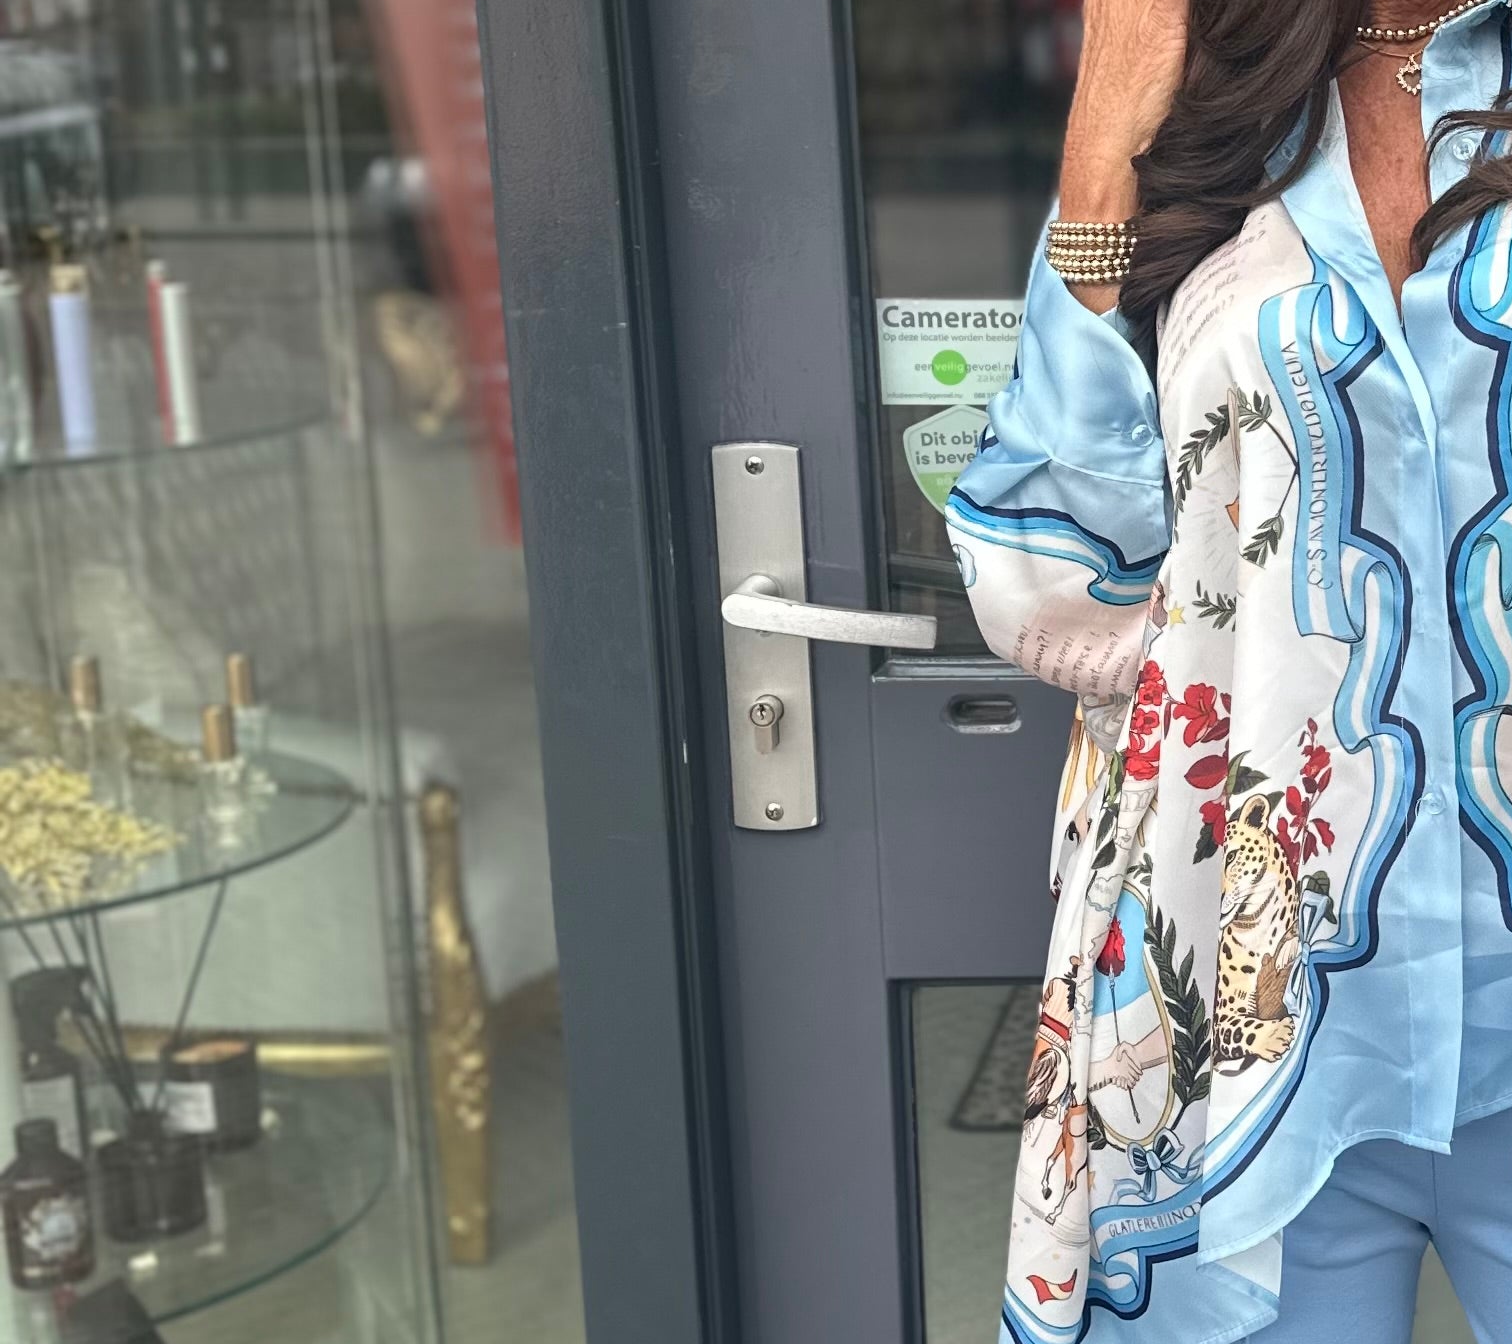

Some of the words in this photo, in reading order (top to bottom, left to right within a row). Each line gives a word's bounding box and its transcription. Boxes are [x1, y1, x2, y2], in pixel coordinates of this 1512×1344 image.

[883, 332, 897, 343] Op
[899, 332, 919, 342] deze
[920, 332, 949, 342] locatie
[951, 332, 984, 342] worden
[920, 431, 947, 446] Dit
[915, 451, 930, 465] is
